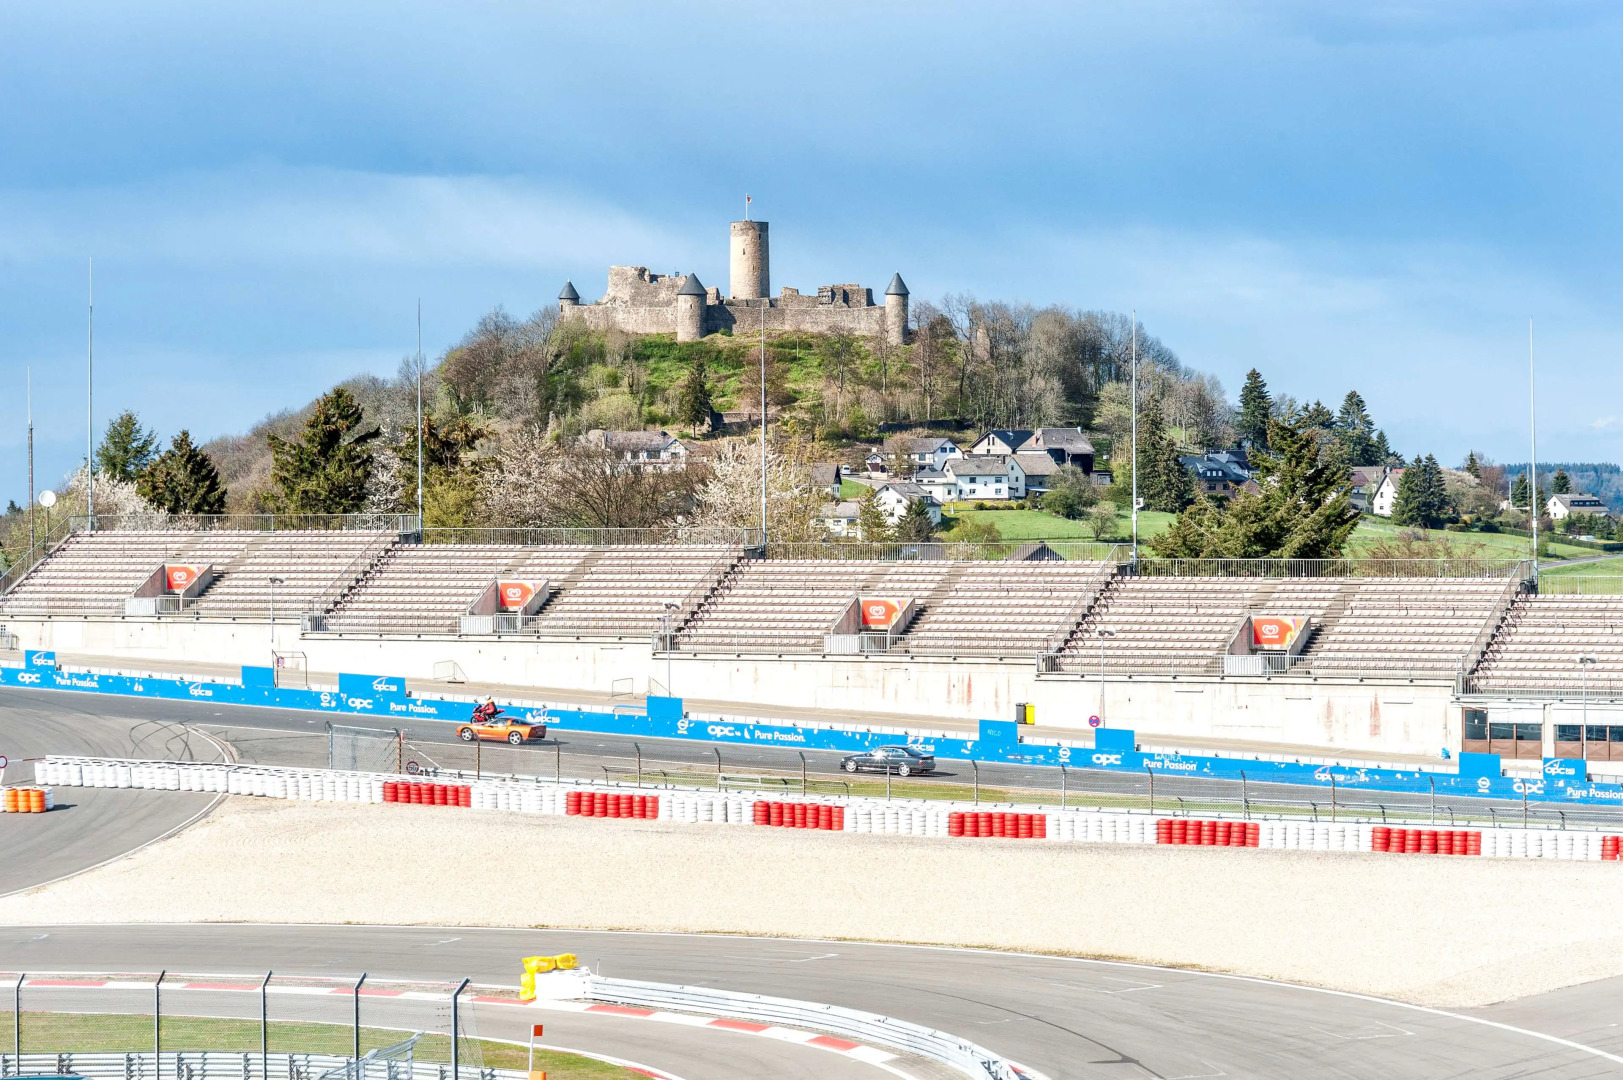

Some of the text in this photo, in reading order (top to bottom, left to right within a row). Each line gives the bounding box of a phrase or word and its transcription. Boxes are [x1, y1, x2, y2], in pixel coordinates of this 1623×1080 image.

[17, 672, 41, 684] opc
[55, 676, 71, 686] Pure
[347, 698, 373, 710] opc
[389, 702, 407, 712] Pure
[707, 725, 735, 738] opc
[754, 730, 772, 740] Pure
[1092, 753, 1122, 766] opc
[1143, 758, 1163, 769] Pure
[1512, 783, 1545, 795] opc
[1566, 787, 1588, 798] Pure
